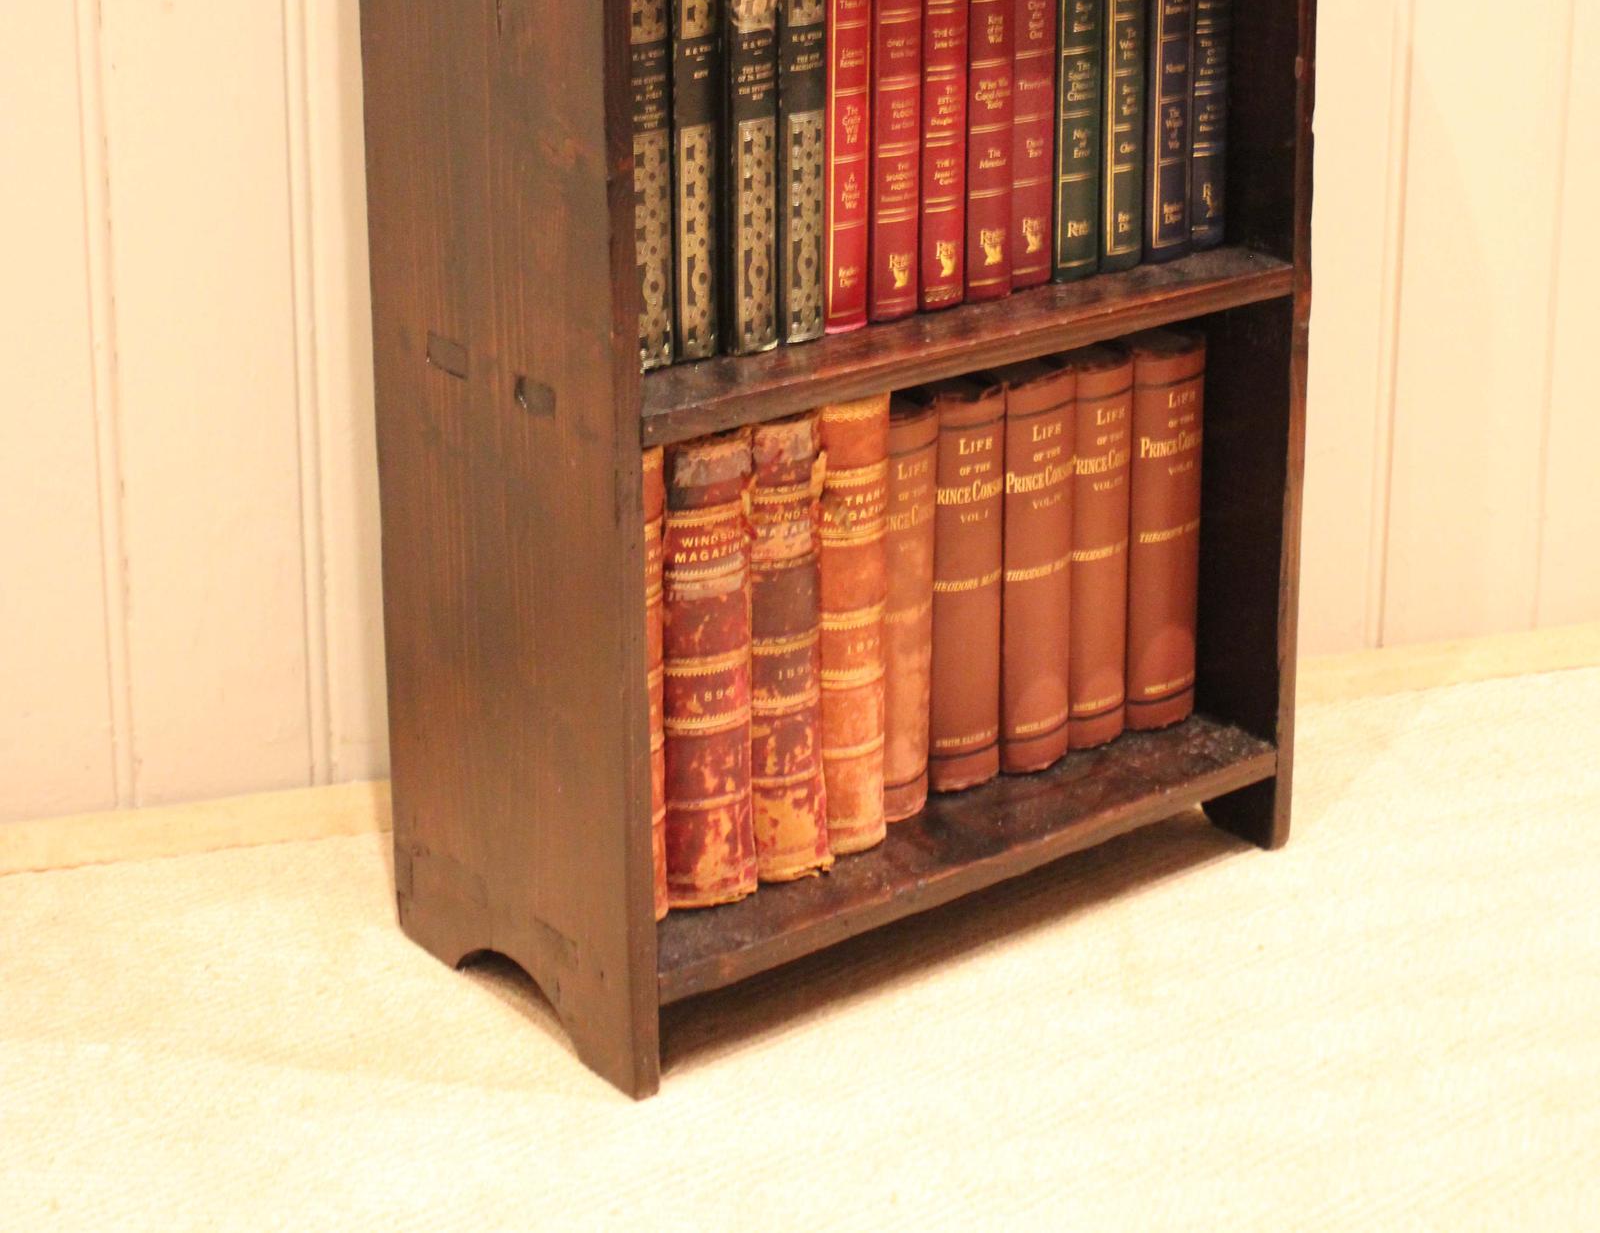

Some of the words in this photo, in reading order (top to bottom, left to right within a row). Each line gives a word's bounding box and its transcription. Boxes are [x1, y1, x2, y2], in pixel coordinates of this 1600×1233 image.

[1168, 390, 1196, 409] LIFE
[1096, 406, 1126, 426] LIFE
[1032, 422, 1062, 443] LIFE
[958, 437, 993, 455] LIFE
[1140, 435, 1177, 459] PRINCE
[1033, 452, 1044, 462] OF
[897, 459, 929, 480] LIFE
[959, 465, 971, 477] OF
[973, 462, 991, 474] THE
[1006, 470, 1045, 494] PRINCE
[936, 487, 971, 506] RINCE
[1071, 544, 1113, 562] HEODORE
[1006, 562, 1051, 582] THEODORE
[934, 577, 979, 592] HEODORE
